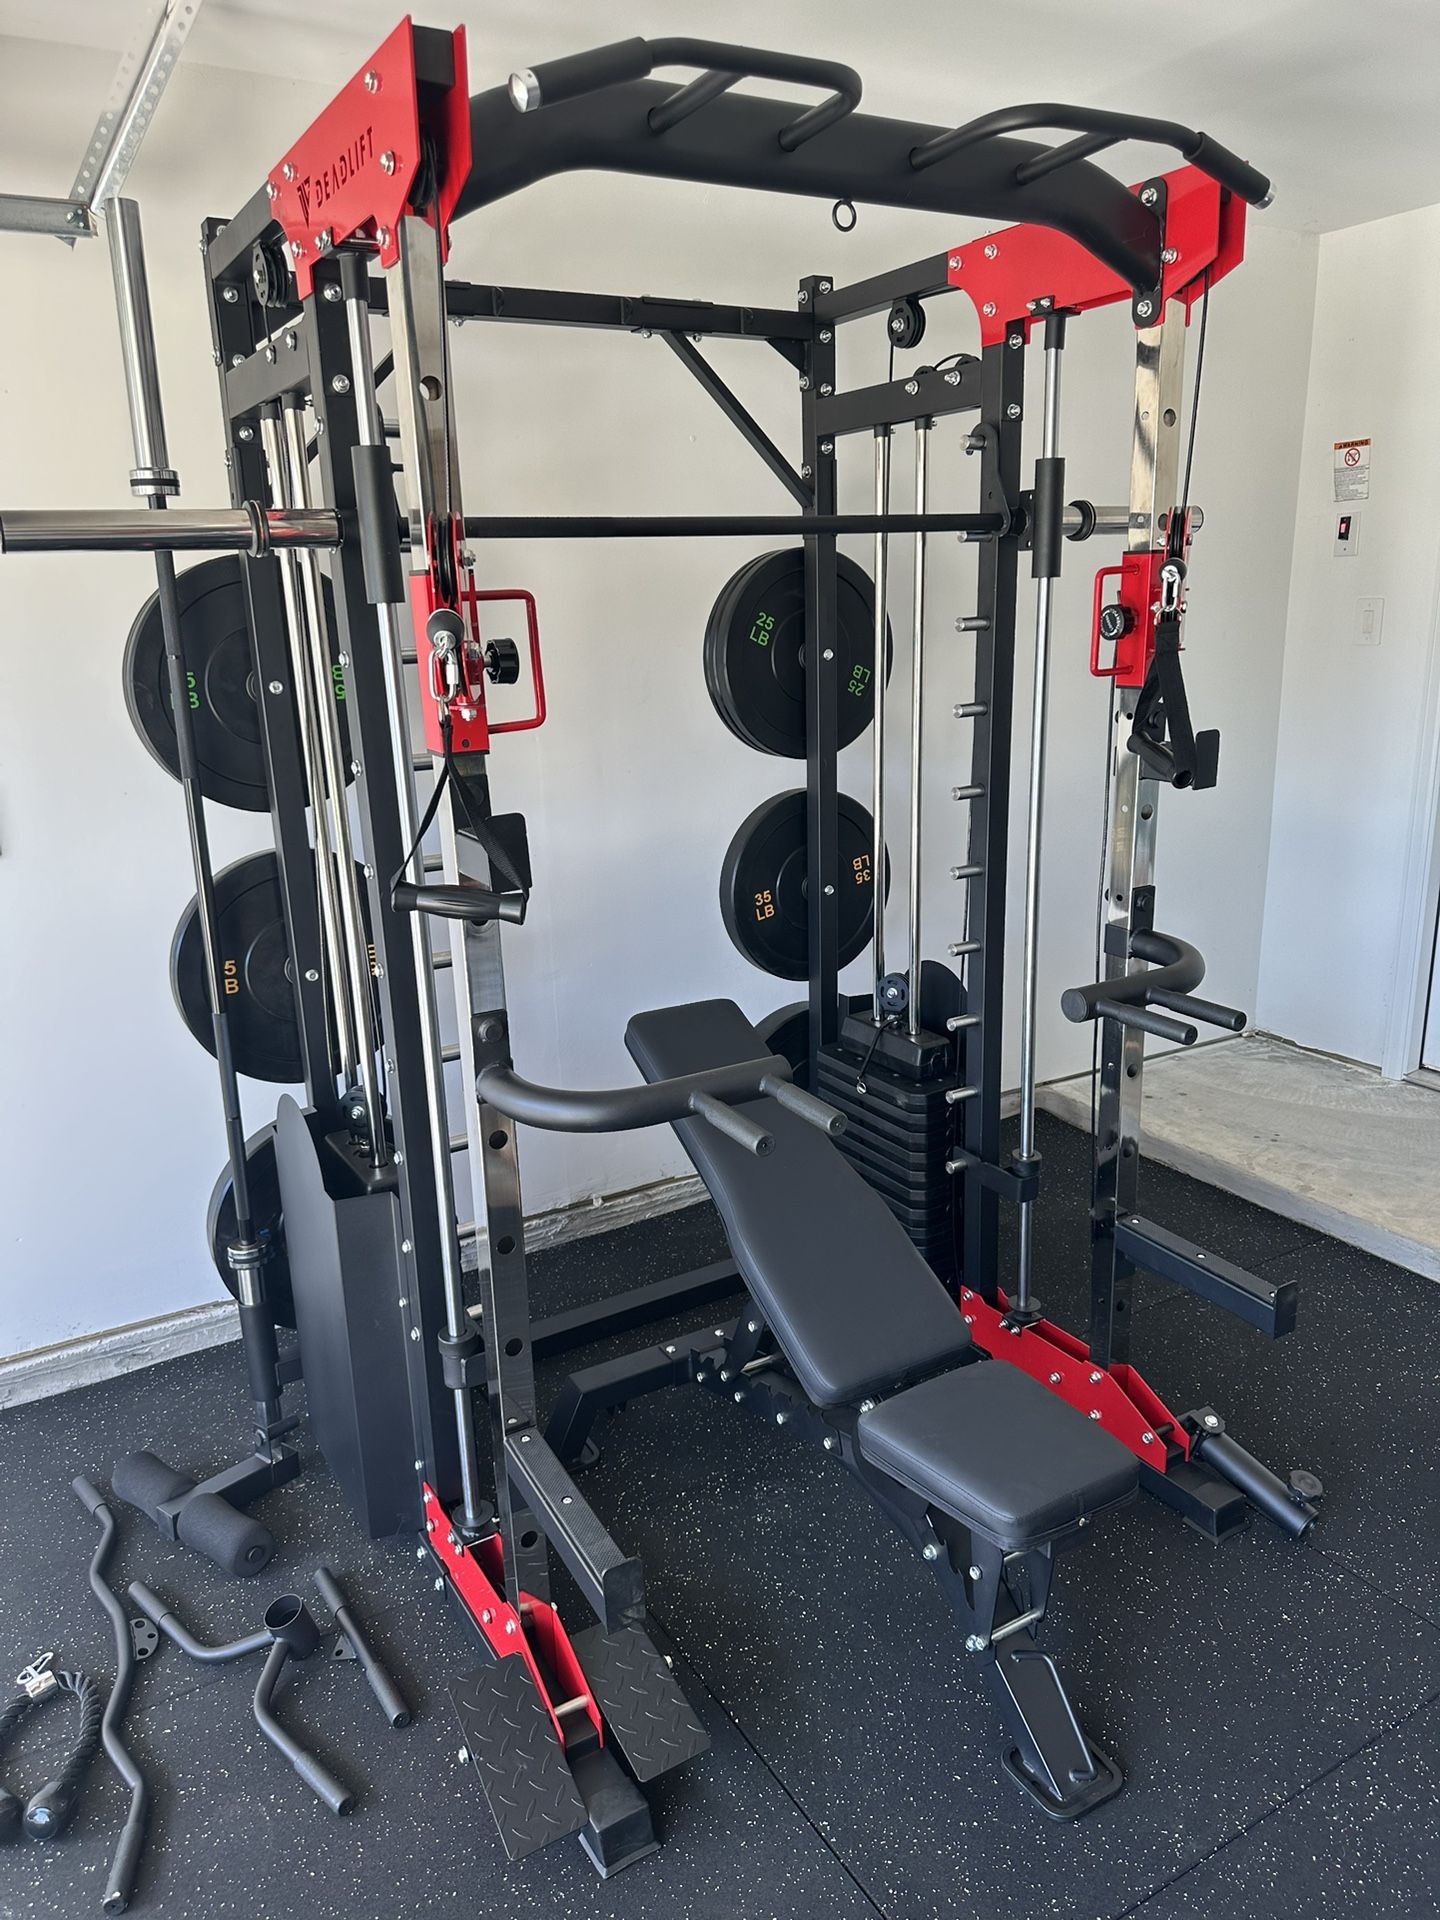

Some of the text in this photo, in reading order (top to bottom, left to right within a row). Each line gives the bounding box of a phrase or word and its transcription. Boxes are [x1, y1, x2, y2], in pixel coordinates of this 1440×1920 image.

[315, 126, 373, 208] DEADLIFT
[756, 612, 775, 630] 25
[749, 626, 770, 646] LB
[852, 665, 871, 683] LB
[847, 680, 865, 696] 25
[852, 855, 870, 871] LB
[855, 869, 871, 885] 35
[754, 890, 772, 906] 35
[756, 904, 775, 921] LB
[224, 960, 237, 975] 5
[224, 978, 240, 994] B
